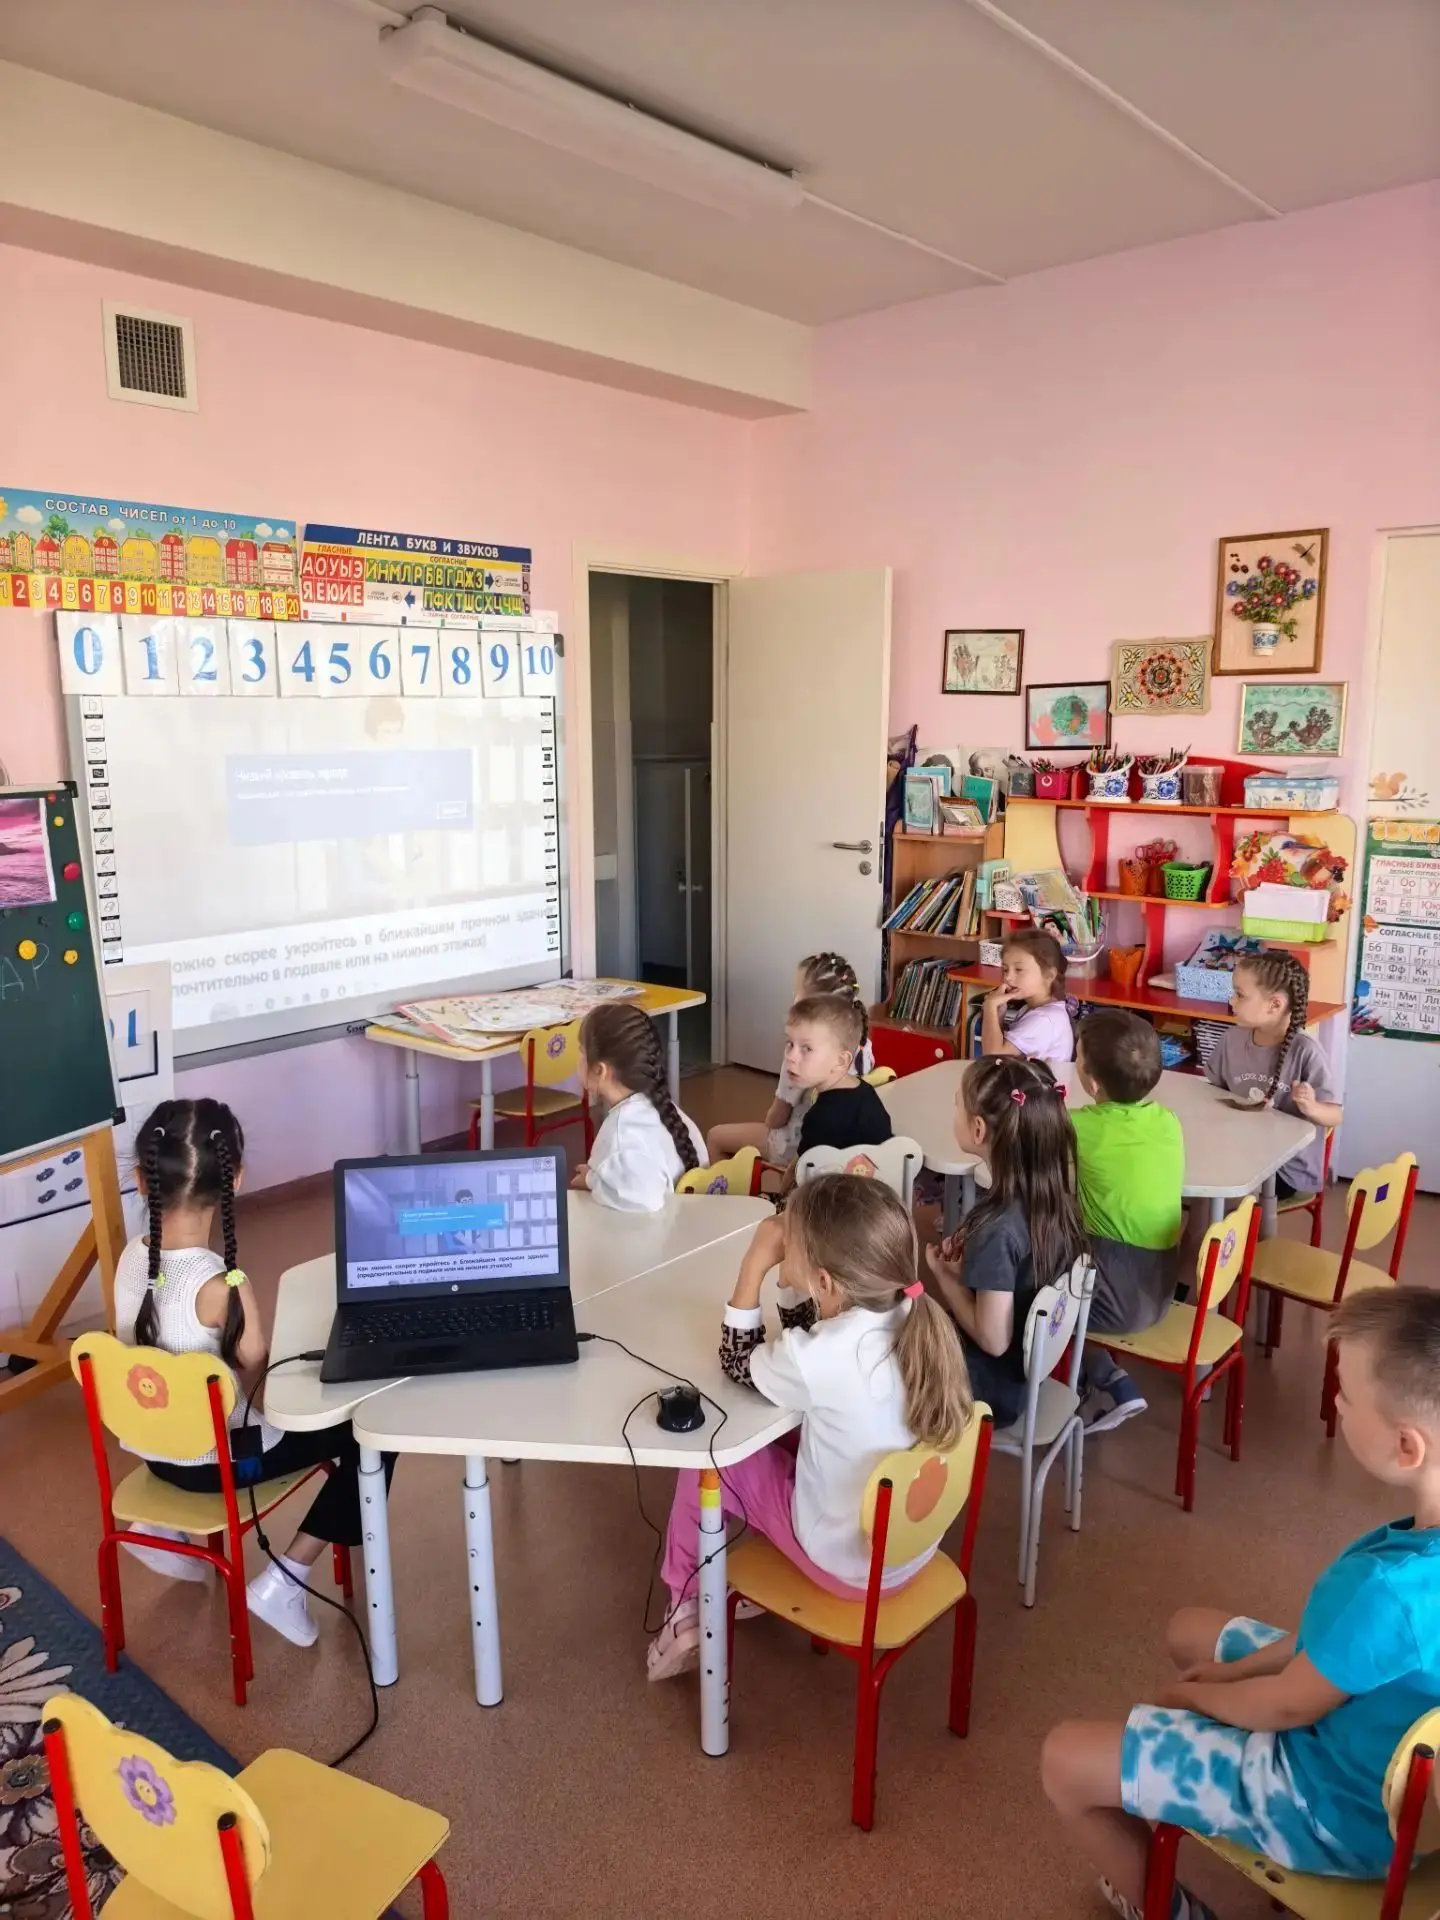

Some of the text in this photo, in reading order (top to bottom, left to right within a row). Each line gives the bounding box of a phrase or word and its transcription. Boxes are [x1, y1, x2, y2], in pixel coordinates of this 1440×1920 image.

[45, 499, 236, 530] СОСТАВ ЧИСЕЛ от 1 до 10
[317, 544, 353, 555] ГЛАСНЫЕ
[357, 532, 499, 558] ЛЕНТА БУКВ И ЗВУКОВ
[429, 556, 468, 566] СОГЛАСНЫЕ
[15, 580, 26, 599] 2
[32, 580, 42, 600] 3
[49, 582, 59, 600] 4
[66, 582, 76, 602] 5
[82, 584, 92, 603] 6
[97, 585, 107, 604] 7
[113, 586, 123, 605] 8
[128, 587, 139, 606] 9
[142, 588, 156, 607] 10
[158, 587, 170, 609] 11
[172, 590, 186, 609] 12
[188, 589, 201, 610] 13
[202, 592, 215, 611] 14
[217, 592, 230, 612] 15
[231, 594, 244, 612] 16
[246, 593, 259, 614] 17
[260, 596, 273, 615] 18
[274, 596, 287, 616] 19
[287, 598, 299, 615] 20
[73, 626, 554, 685] 0 1 2 3 4 5 6 7 8 9 10
[224, 947, 277, 966] скорее
[284, 936, 357, 960] укройтесь
[378, 920, 455, 943] ближайшем
[461, 913, 510, 931] прочном
[1379, 928, 1431, 940] СОГЛАСНЫЕ
[272, 968, 281, 981] в
[284, 957, 342, 979] подвале
[345, 953, 371, 969] или
[374, 951, 389, 963] на
[392, 943, 439, 961] нижних
[1388, 965, 1406, 974] Фф
[1399, 992, 1417, 1001] Мм
[1396, 1012, 1408, 1021] Хх
